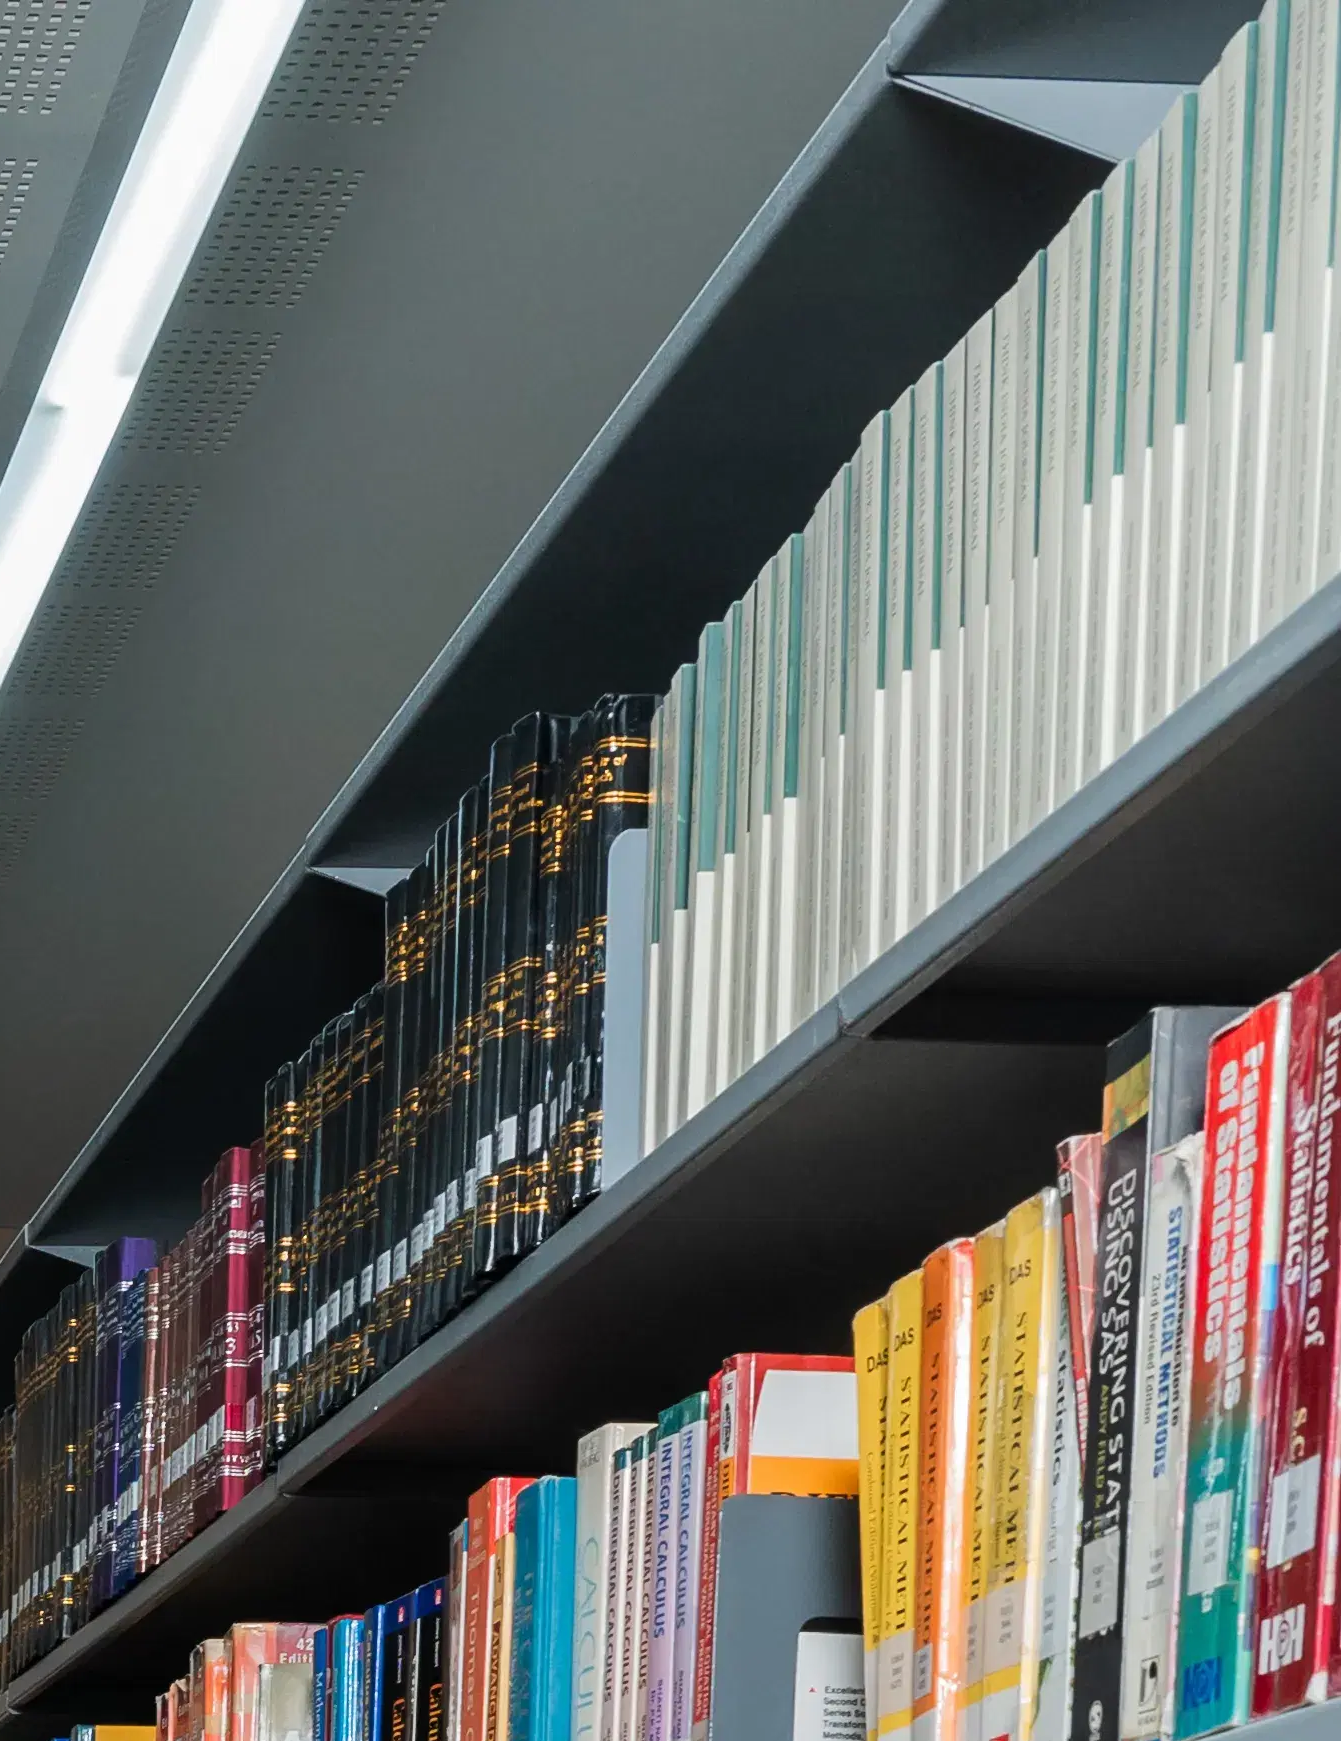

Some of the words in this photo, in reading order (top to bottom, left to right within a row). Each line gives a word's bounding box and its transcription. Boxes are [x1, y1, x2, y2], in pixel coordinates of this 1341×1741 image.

[1102, 1178, 1122, 1298] USING
[1224, 1041, 1265, 1410] Fundamentals
[1285, 1100, 1316, 1286] Statistics
[1009, 1259, 1032, 1285] DAS
[1109, 1168, 1137, 1423] DISCOVERING
[1161, 1206, 1184, 1360] STATISTICAL
[894, 1327, 914, 1352] DAS
[1099, 1313, 1117, 1376] SAS
[1305, 1305, 1325, 1348] of
[1152, 1361, 1171, 1479] METHODS
[658, 1441, 673, 1542] INTEGRAL
[680, 1429, 693, 1521] INTEGRAL
[653, 1550, 669, 1638] CALCULUS
[675, 1530, 690, 1629] CALCULUS
[637, 1592, 652, 1690] CALCULUS
